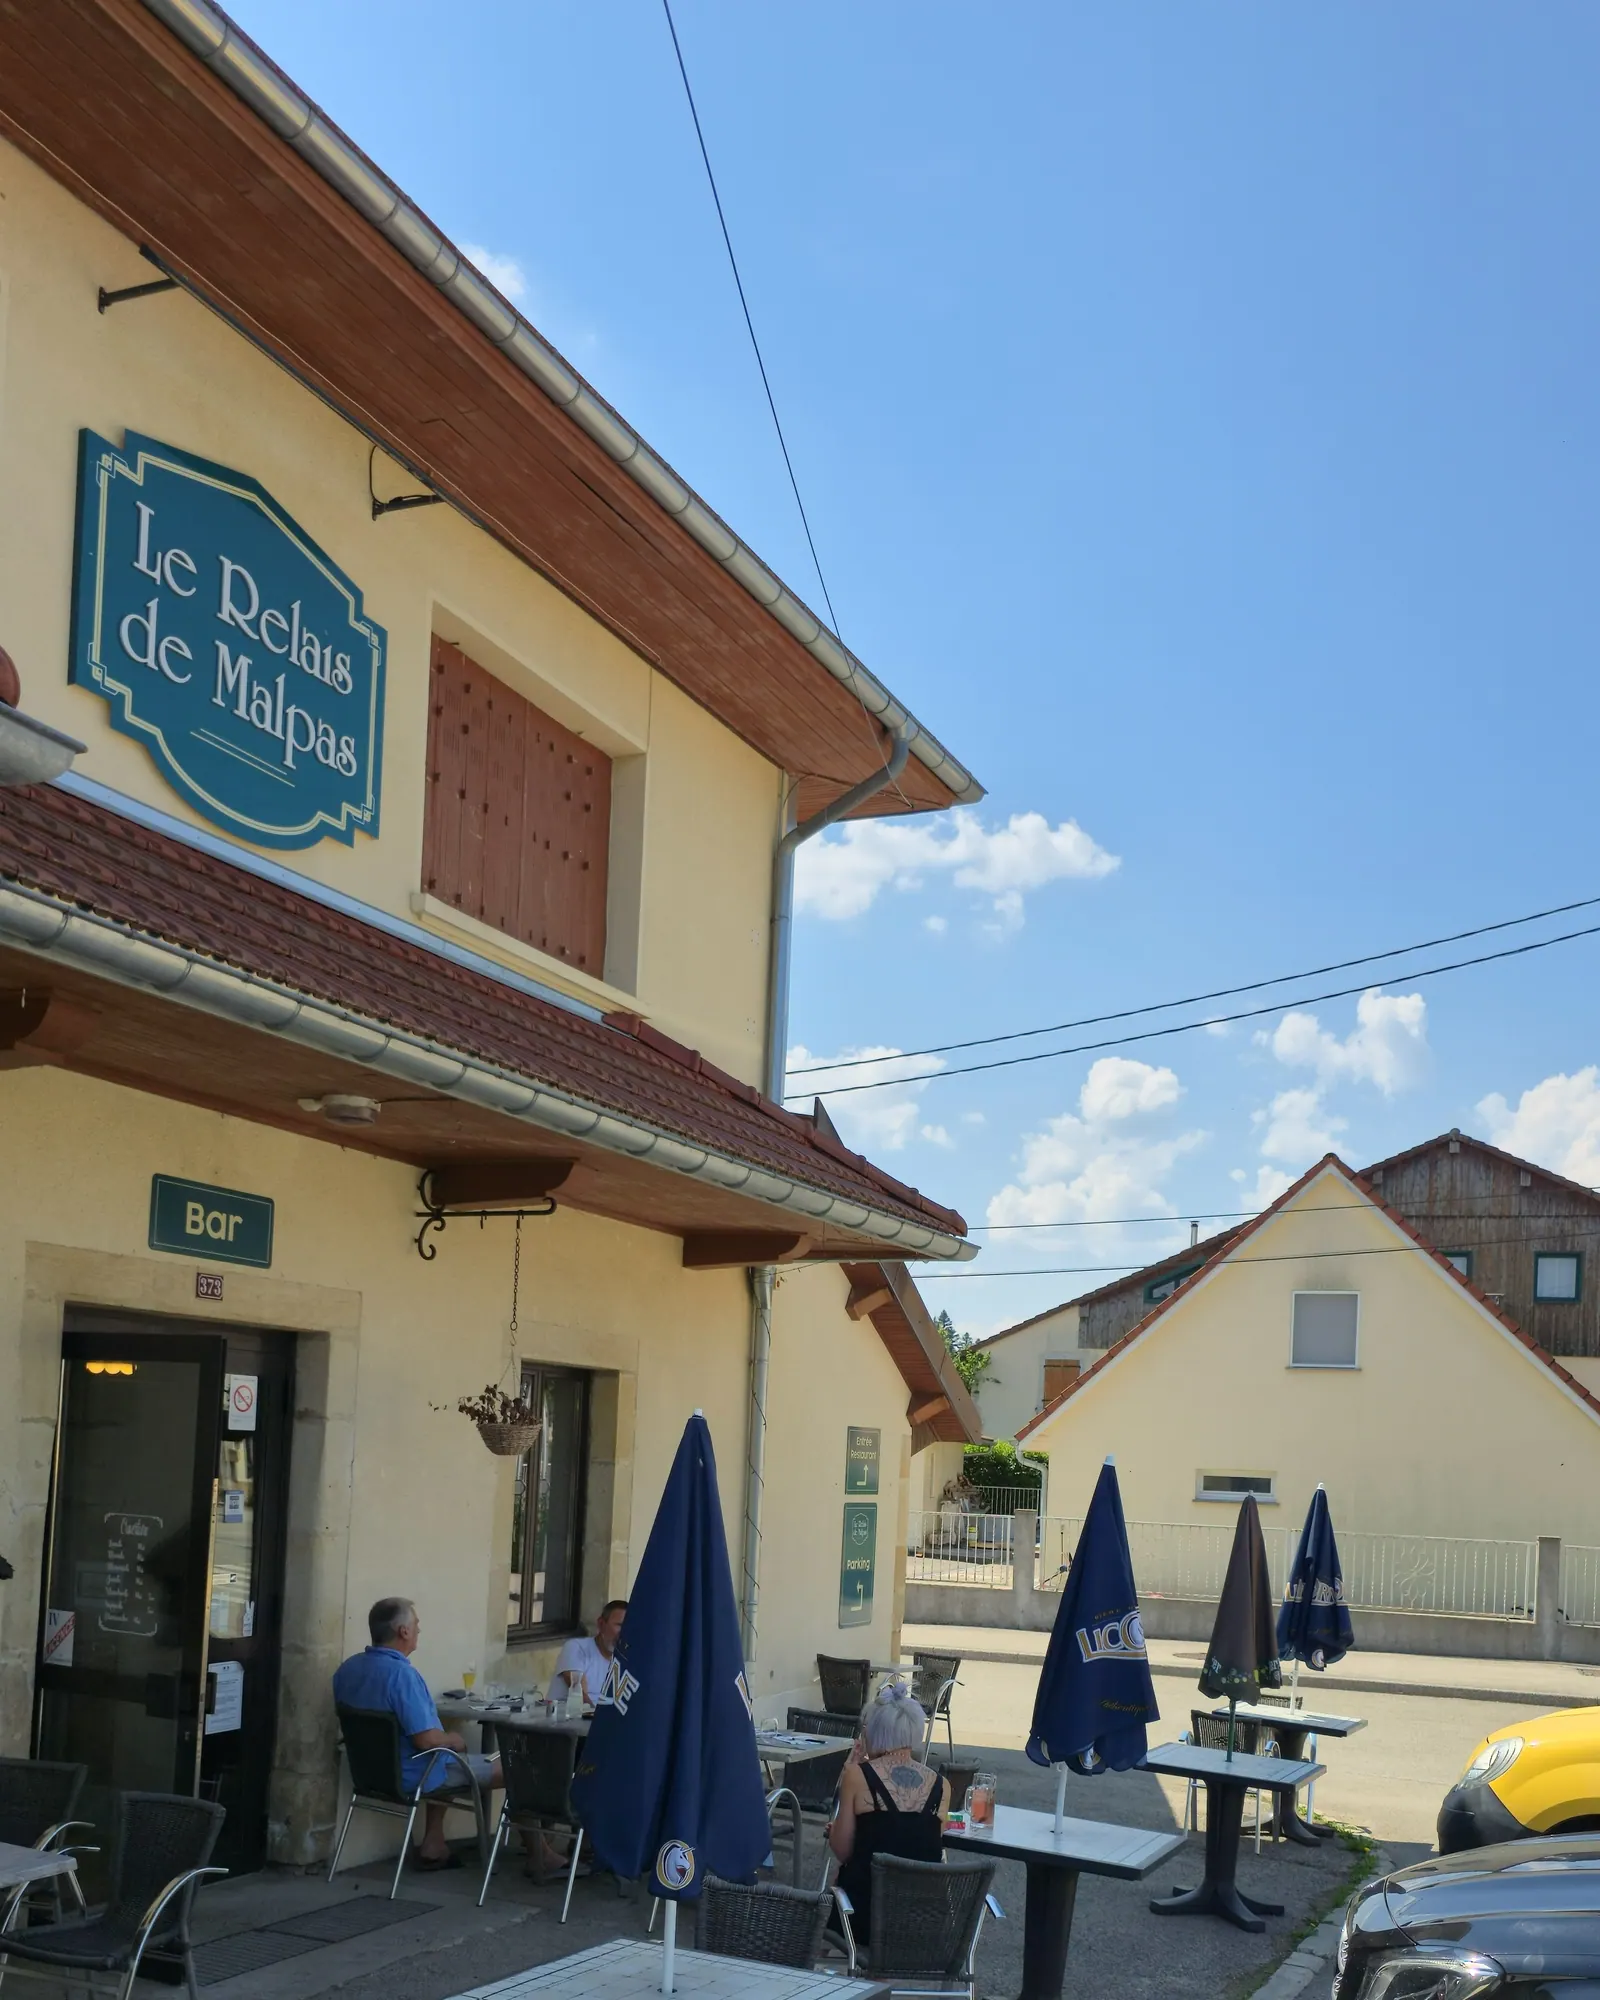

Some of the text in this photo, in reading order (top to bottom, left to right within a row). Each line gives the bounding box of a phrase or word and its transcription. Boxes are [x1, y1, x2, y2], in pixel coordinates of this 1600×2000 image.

[133, 501, 353, 696] Le Relais
[119, 598, 357, 777] de Malpas
[185, 1201, 243, 1242] Bar
[200, 1277, 221, 1297] 373
[856, 1435, 873, 1447] Entrée
[850, 1449, 877, 1460] Restaurant
[847, 1556, 870, 1571] Parking
